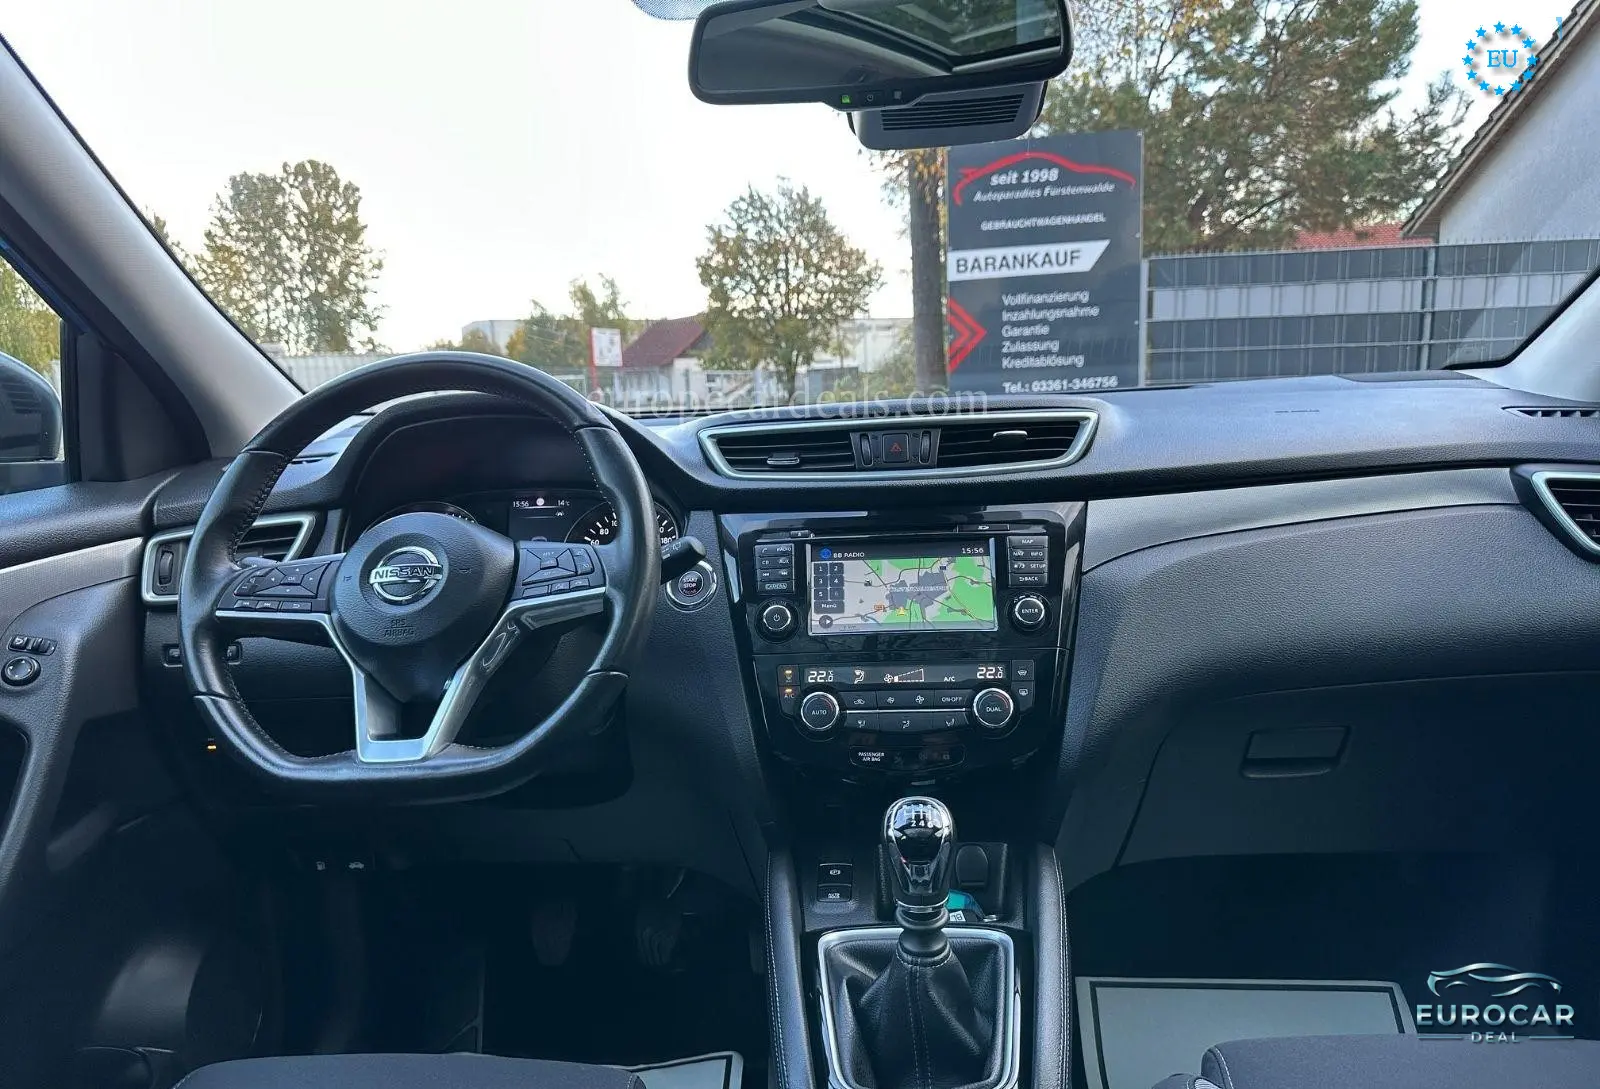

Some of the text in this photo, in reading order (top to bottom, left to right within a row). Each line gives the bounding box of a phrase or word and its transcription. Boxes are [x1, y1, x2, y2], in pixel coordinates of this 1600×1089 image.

[1021, 168, 1060, 183] 1998
[955, 249, 1082, 275] BARANKAUF
[1001, 289, 1090, 306] Vollfinanzierung
[1001, 305, 1100, 322] Inzahlungsnahme
[1001, 323, 1050, 337] Garantie
[1001, 339, 1060, 353] Zulassung
[374, 565, 435, 580] NISSAN
